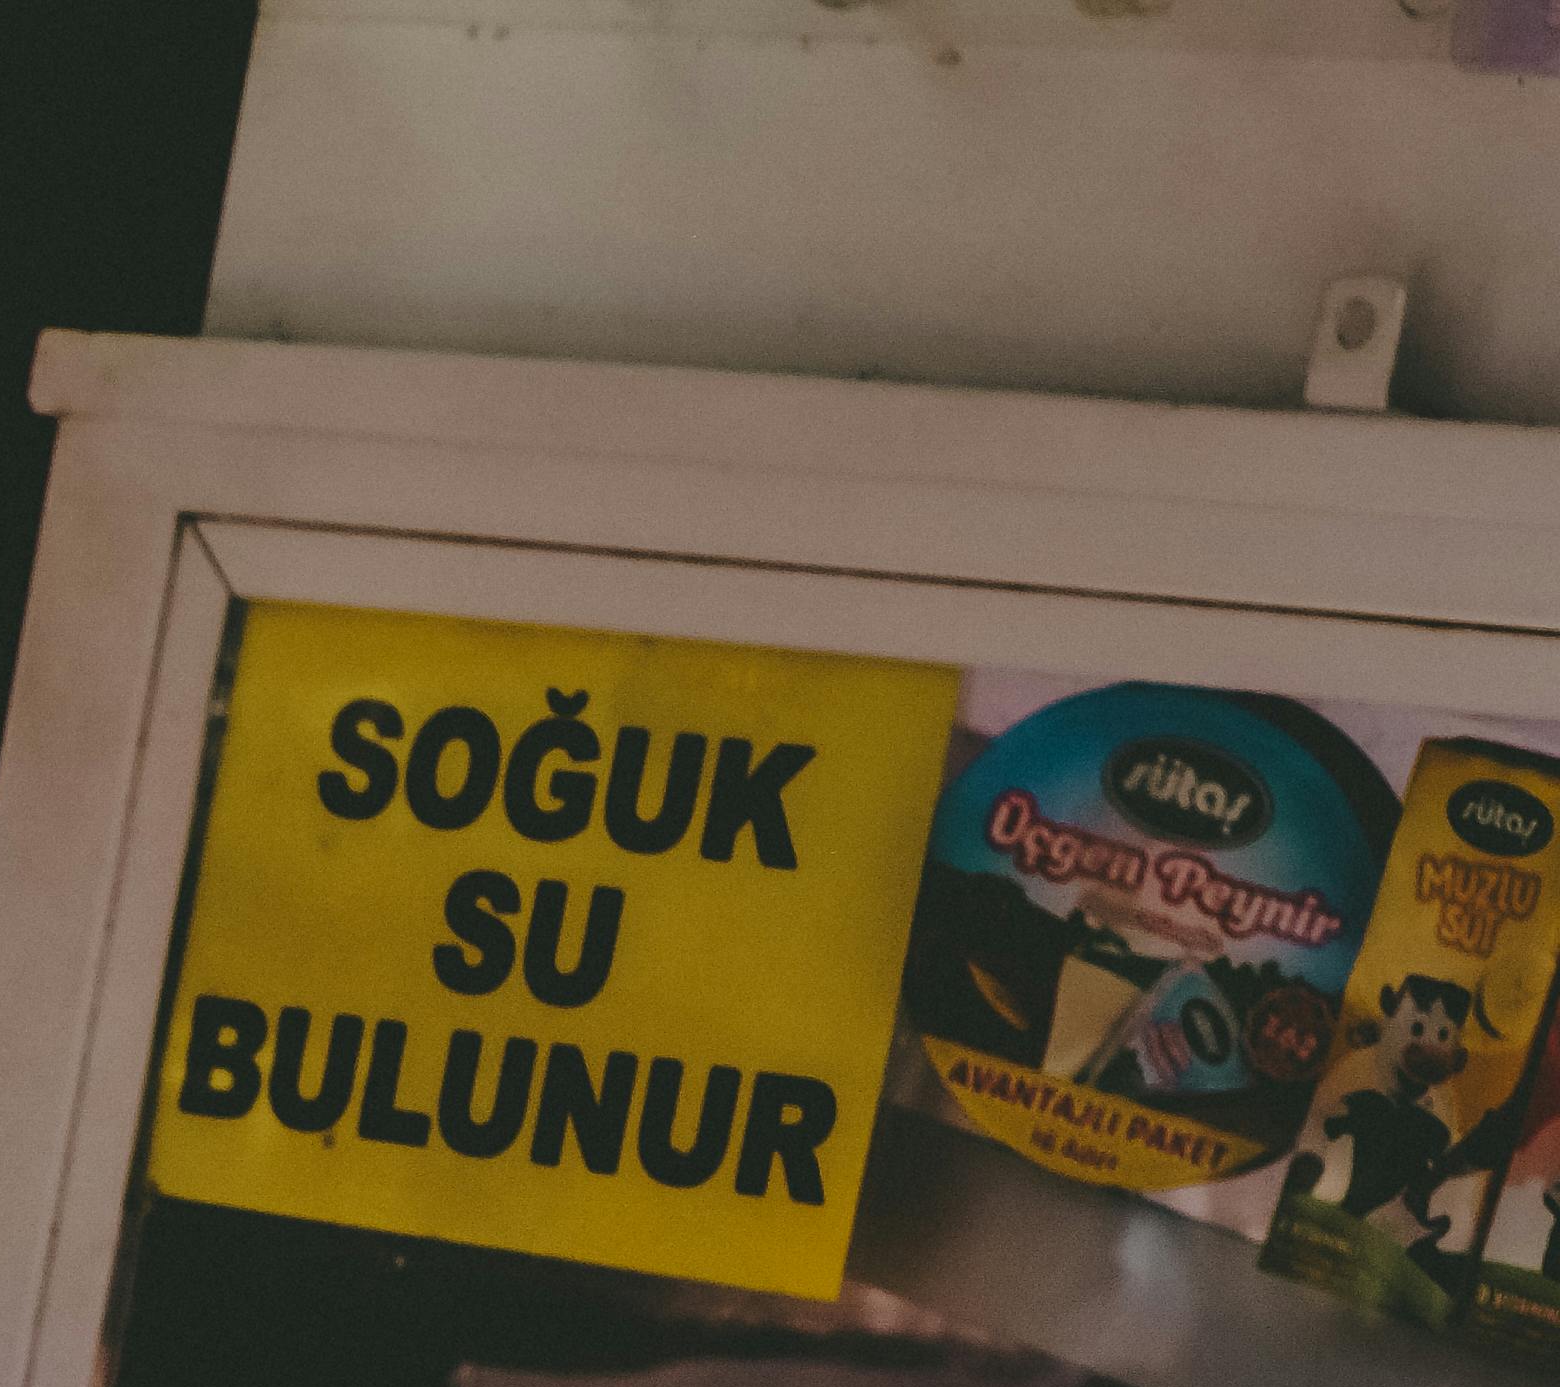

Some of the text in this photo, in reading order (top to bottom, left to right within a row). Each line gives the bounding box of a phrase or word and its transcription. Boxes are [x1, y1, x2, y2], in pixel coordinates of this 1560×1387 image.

[317, 687, 817, 871] SOĞUK
[433, 870, 625, 1008] SU
[1155, 851, 1343, 946] Peynir
[178, 995, 838, 1206] BULUNUR
[1126, 1114, 1228, 1173] PAKET
